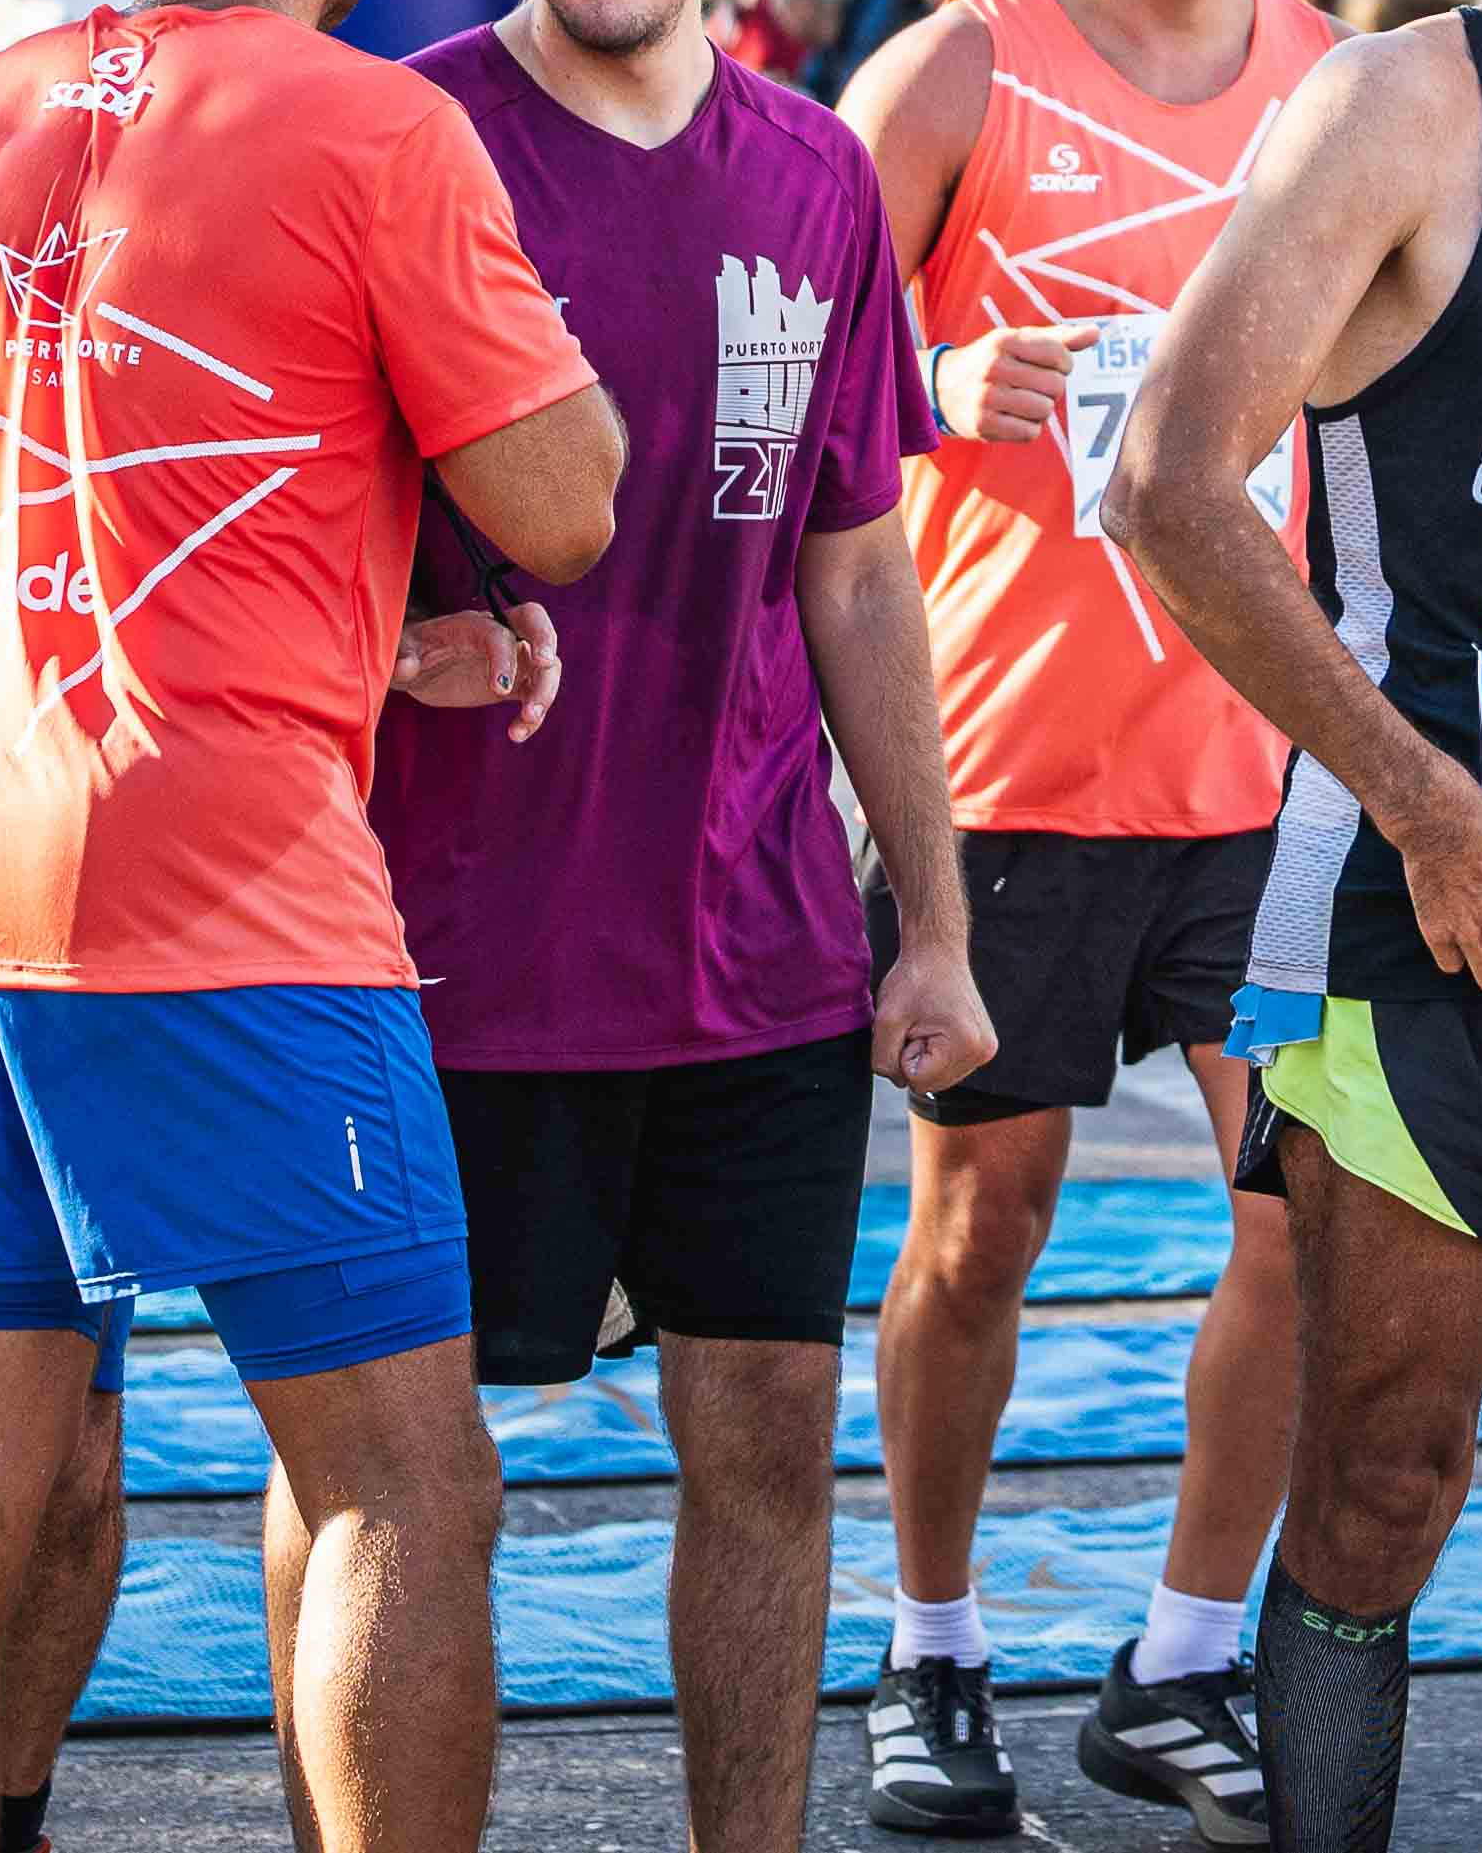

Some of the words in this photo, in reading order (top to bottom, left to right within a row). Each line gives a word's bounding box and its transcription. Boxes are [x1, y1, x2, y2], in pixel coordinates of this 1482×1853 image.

[725, 342, 786, 357] PUERTO
[791, 340, 822, 355] NORT
[1077, 392, 1127, 458] 7
